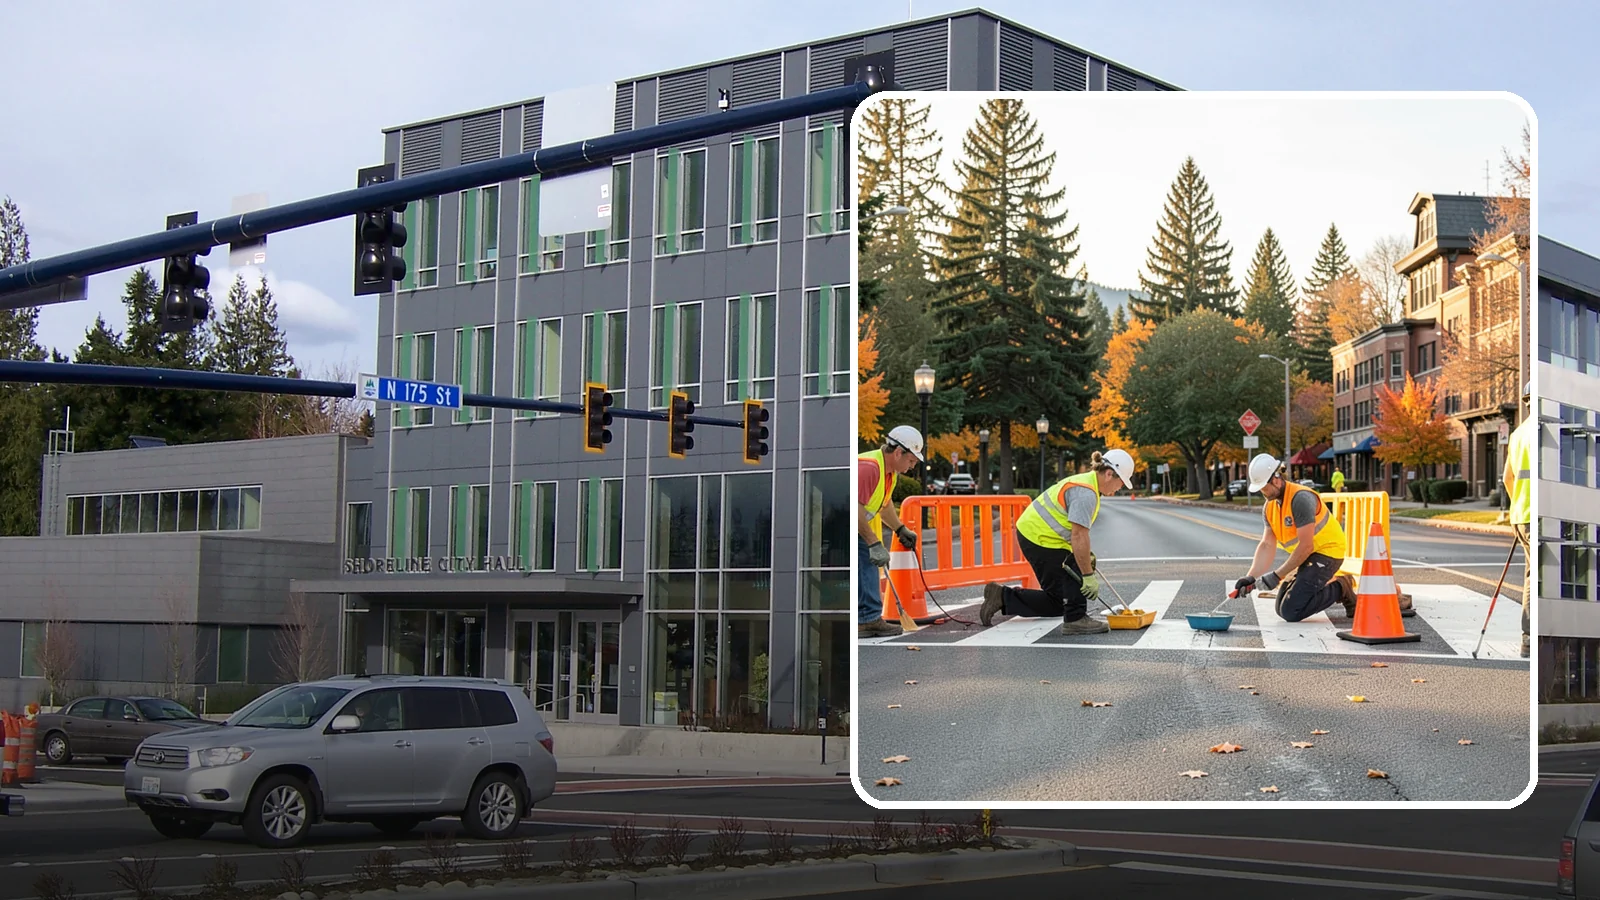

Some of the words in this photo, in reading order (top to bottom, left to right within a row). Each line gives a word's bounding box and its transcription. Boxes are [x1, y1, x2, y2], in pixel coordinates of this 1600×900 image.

[387, 380, 396, 400] N
[405, 382, 427, 403] 175
[436, 386, 451, 406] St
[344, 557, 432, 573] SHORELINE
[438, 556, 475, 572] CITY
[484, 555, 525, 571] HALL
